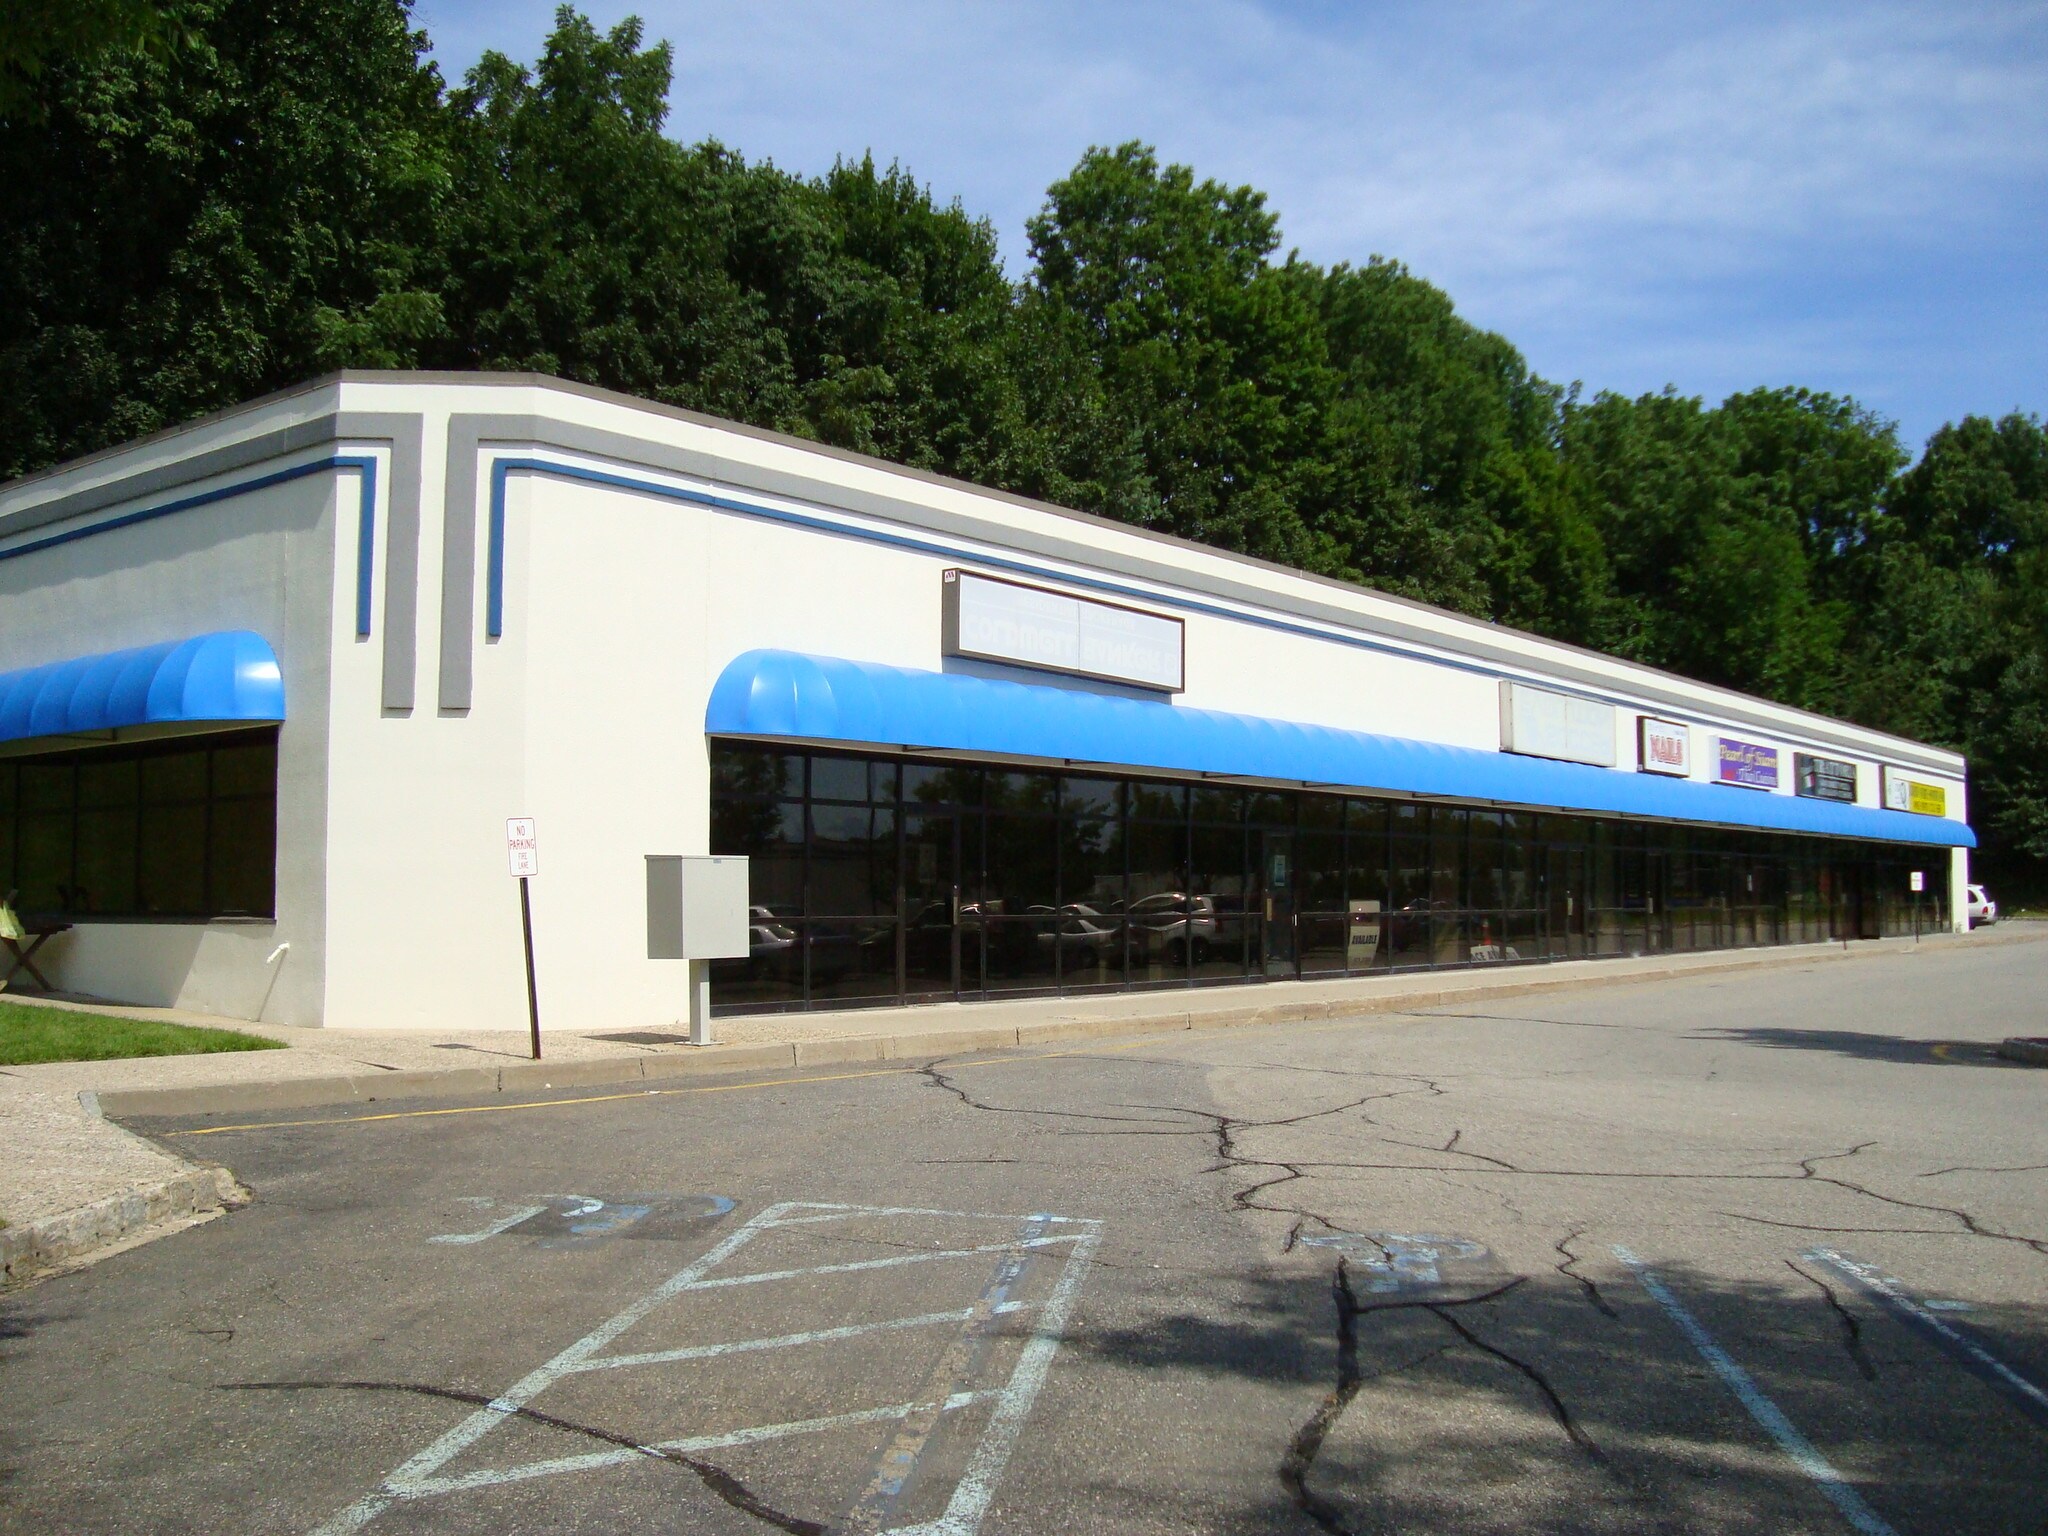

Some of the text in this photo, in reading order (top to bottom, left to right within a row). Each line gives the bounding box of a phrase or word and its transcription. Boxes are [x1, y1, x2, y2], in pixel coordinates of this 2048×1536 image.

[1650, 734, 1682, 766] NAILS
[517, 825, 526, 836] NO
[509, 838, 535, 850] PARKING
[1351, 934, 1378, 945] AVAILABLE
